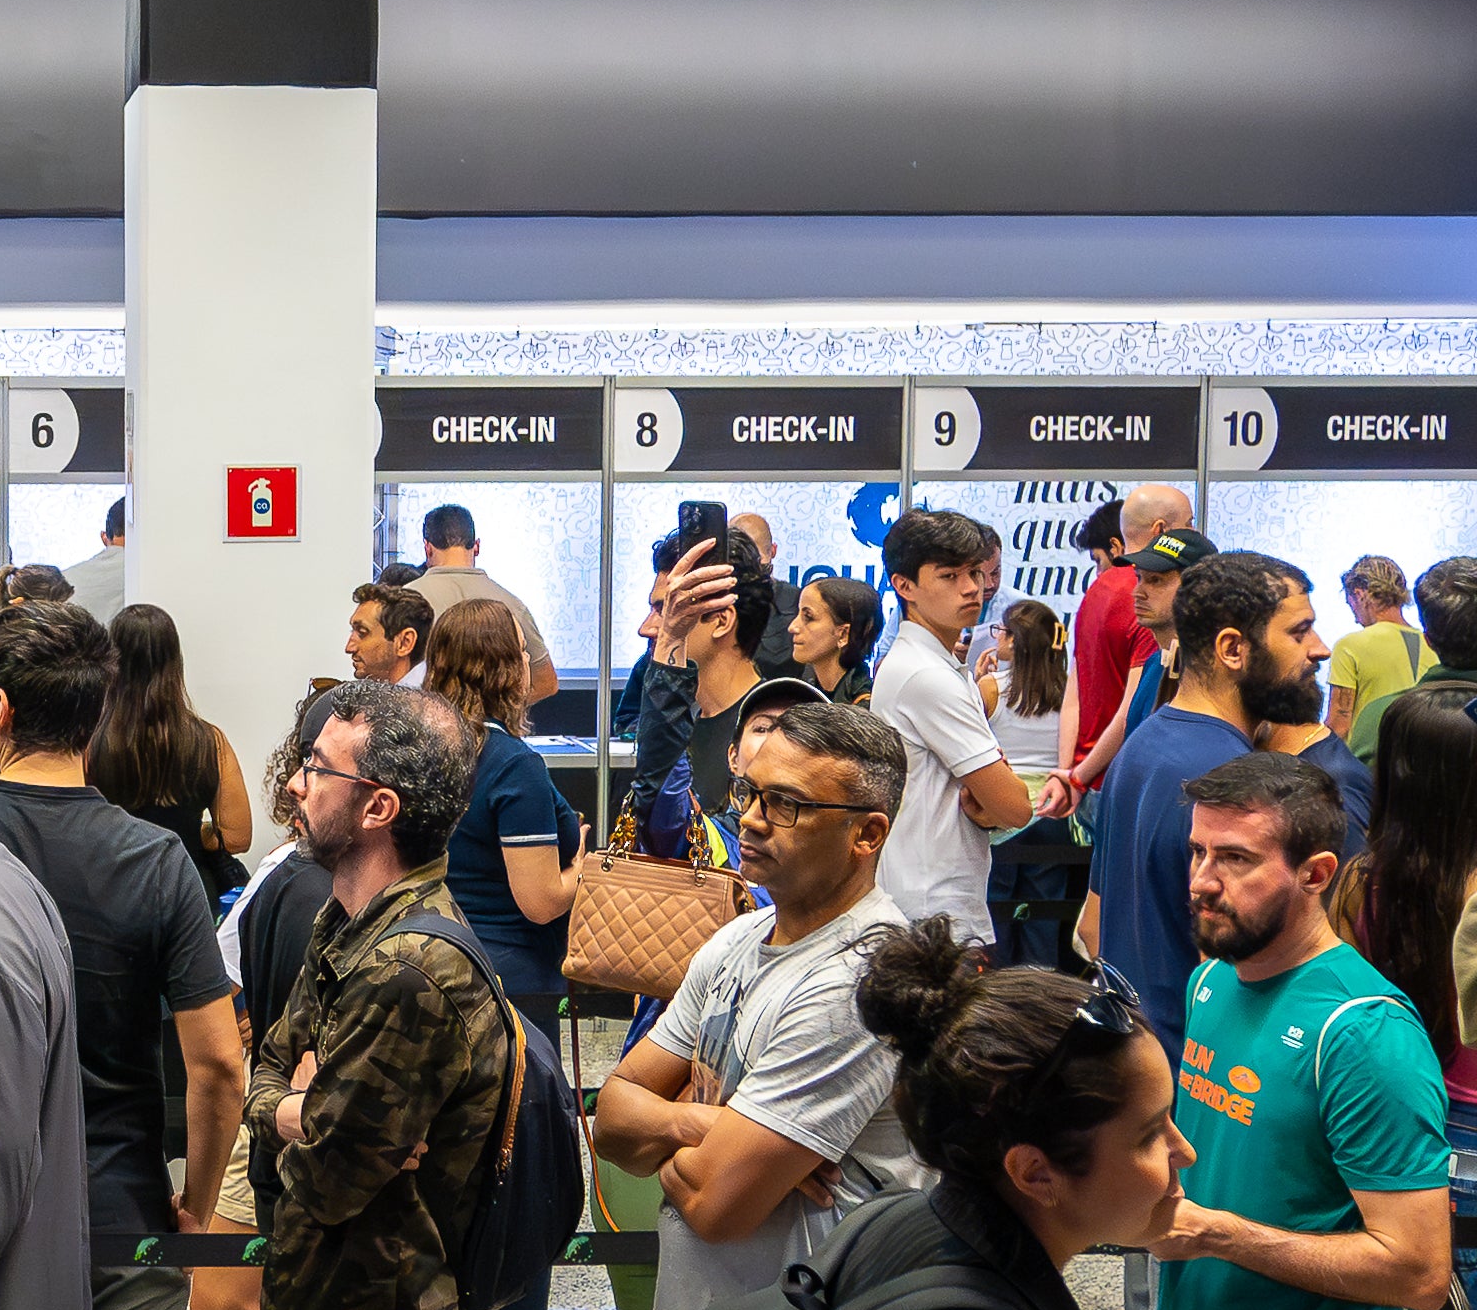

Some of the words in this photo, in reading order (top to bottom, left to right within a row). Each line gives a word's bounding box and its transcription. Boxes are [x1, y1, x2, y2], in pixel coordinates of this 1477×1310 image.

[31, 412, 54, 448] 6
[432, 415, 555, 443] CHECK-IN
[636, 412, 658, 448] 8
[732, 415, 855, 443] CHECK-IN
[934, 411, 956, 447] 9
[1029, 415, 1151, 442] CHECK-IN
[1223, 410, 1263, 447] 10
[1326, 415, 1447, 441] CHECK-IN
[1190, 1074, 1256, 1127] BRIDGE
